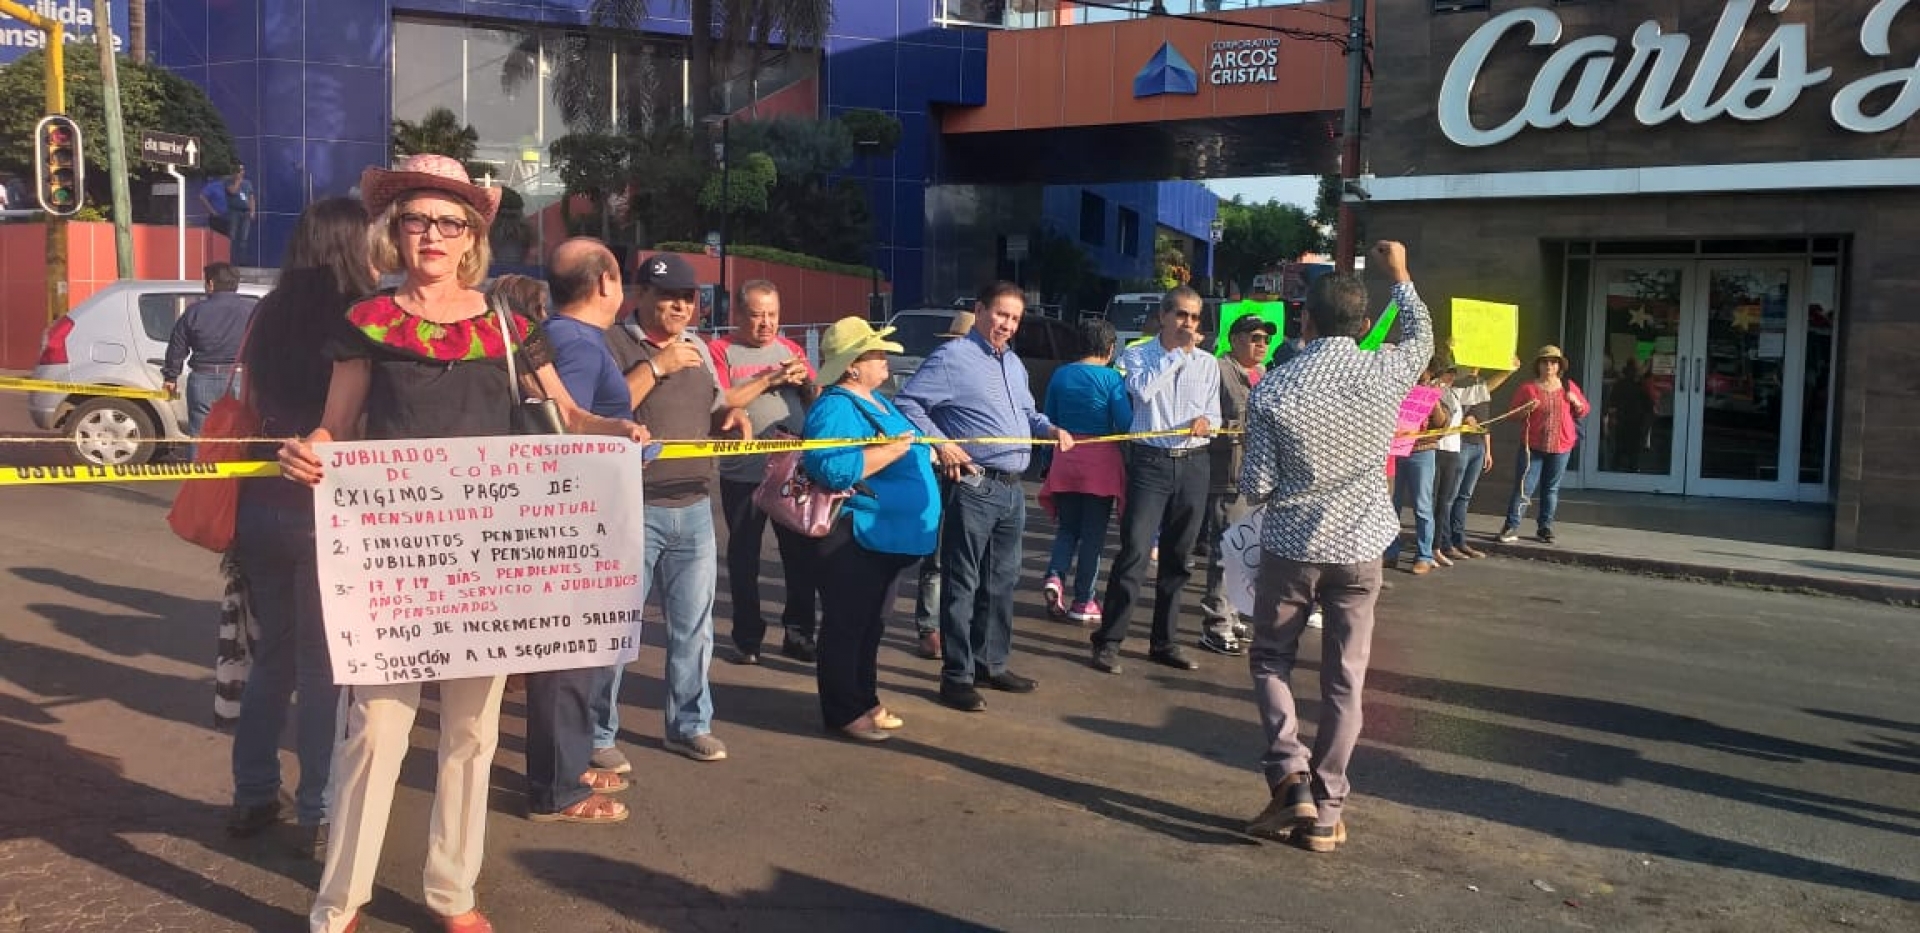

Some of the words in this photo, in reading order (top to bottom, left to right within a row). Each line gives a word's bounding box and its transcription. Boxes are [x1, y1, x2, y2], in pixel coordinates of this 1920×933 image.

[1210, 48, 1278, 68] ARCOS
[1211, 67, 1278, 84] CRISTAL
[1438, 0, 1832, 147] Carl's
[332, 448, 448, 468] JUBILADOS
[477, 446, 487, 462] Y
[509, 442, 626, 459] PENSIONADOS
[386, 467, 412, 482] DE
[334, 486, 444, 508] EXIGIMOS
[464, 483, 520, 503] PAGOS
[361, 506, 494, 526] MENSUALIDAD
[519, 500, 599, 518] PUNTUAL
[362, 532, 464, 553] FINIQUITOS
[481, 525, 580, 543] PENDIENTES
[596, 522, 608, 536] A
[362, 552, 458, 571] JUBILADOS
[471, 548, 480, 564] Y
[491, 544, 600, 562] PENSIONADOS
[496, 562, 583, 579] PENDIENTES
[595, 559, 621, 573] POR
[458, 584, 532, 599] SERVICIO
[543, 581, 553, 594] A
[561, 574, 638, 591] JUBILADOS
[392, 601, 498, 620] PENSIONADOS
[376, 623, 421, 641] PAGO
[432, 620, 454, 636] DE
[463, 614, 571, 634] INCREMENTO
[466, 649, 478, 662] A
[487, 647, 507, 660] LA
[515, 638, 598, 659] SEGURIDAD
